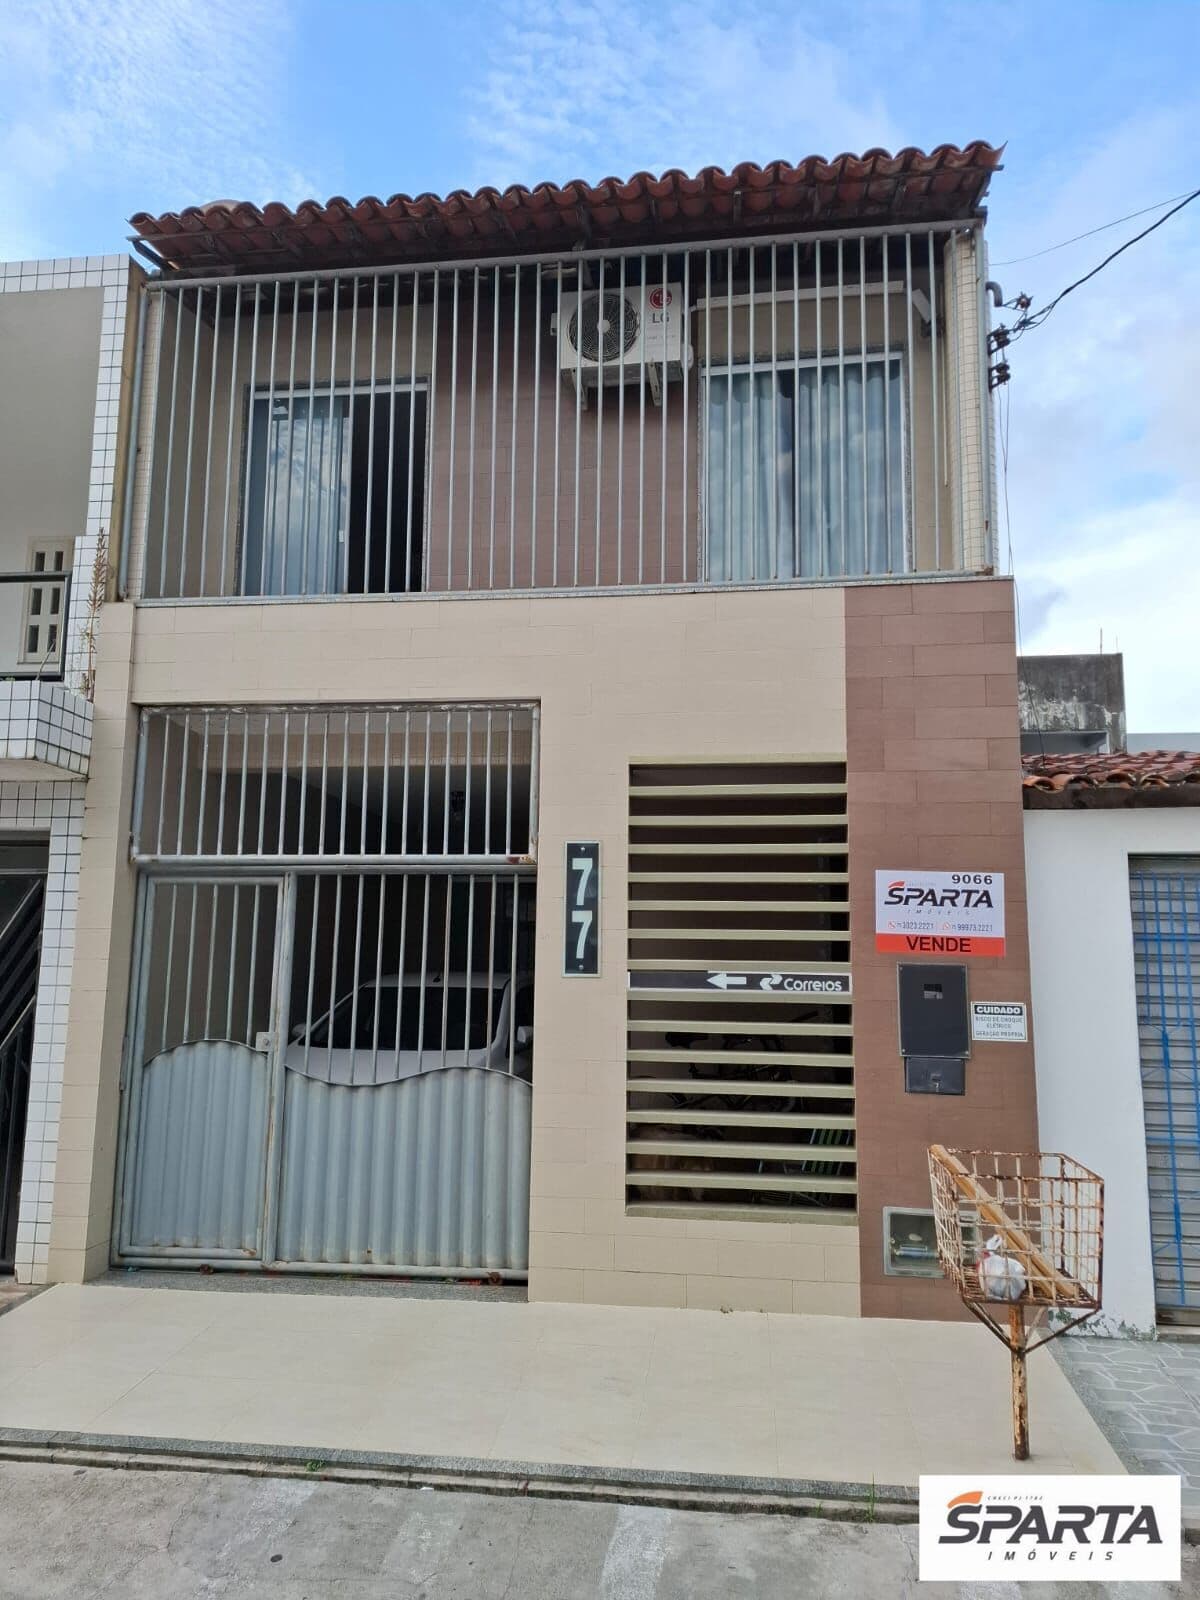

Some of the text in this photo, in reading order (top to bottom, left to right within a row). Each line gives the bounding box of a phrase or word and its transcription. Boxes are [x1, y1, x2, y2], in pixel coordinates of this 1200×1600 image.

[652, 312, 670, 324] LG
[951, 874, 993, 885] 9066
[884, 886, 994, 908] SPARTA
[906, 936, 972, 953] VENDE
[783, 977, 843, 992] Correios
[976, 1006, 1021, 1015] CUIDADO
